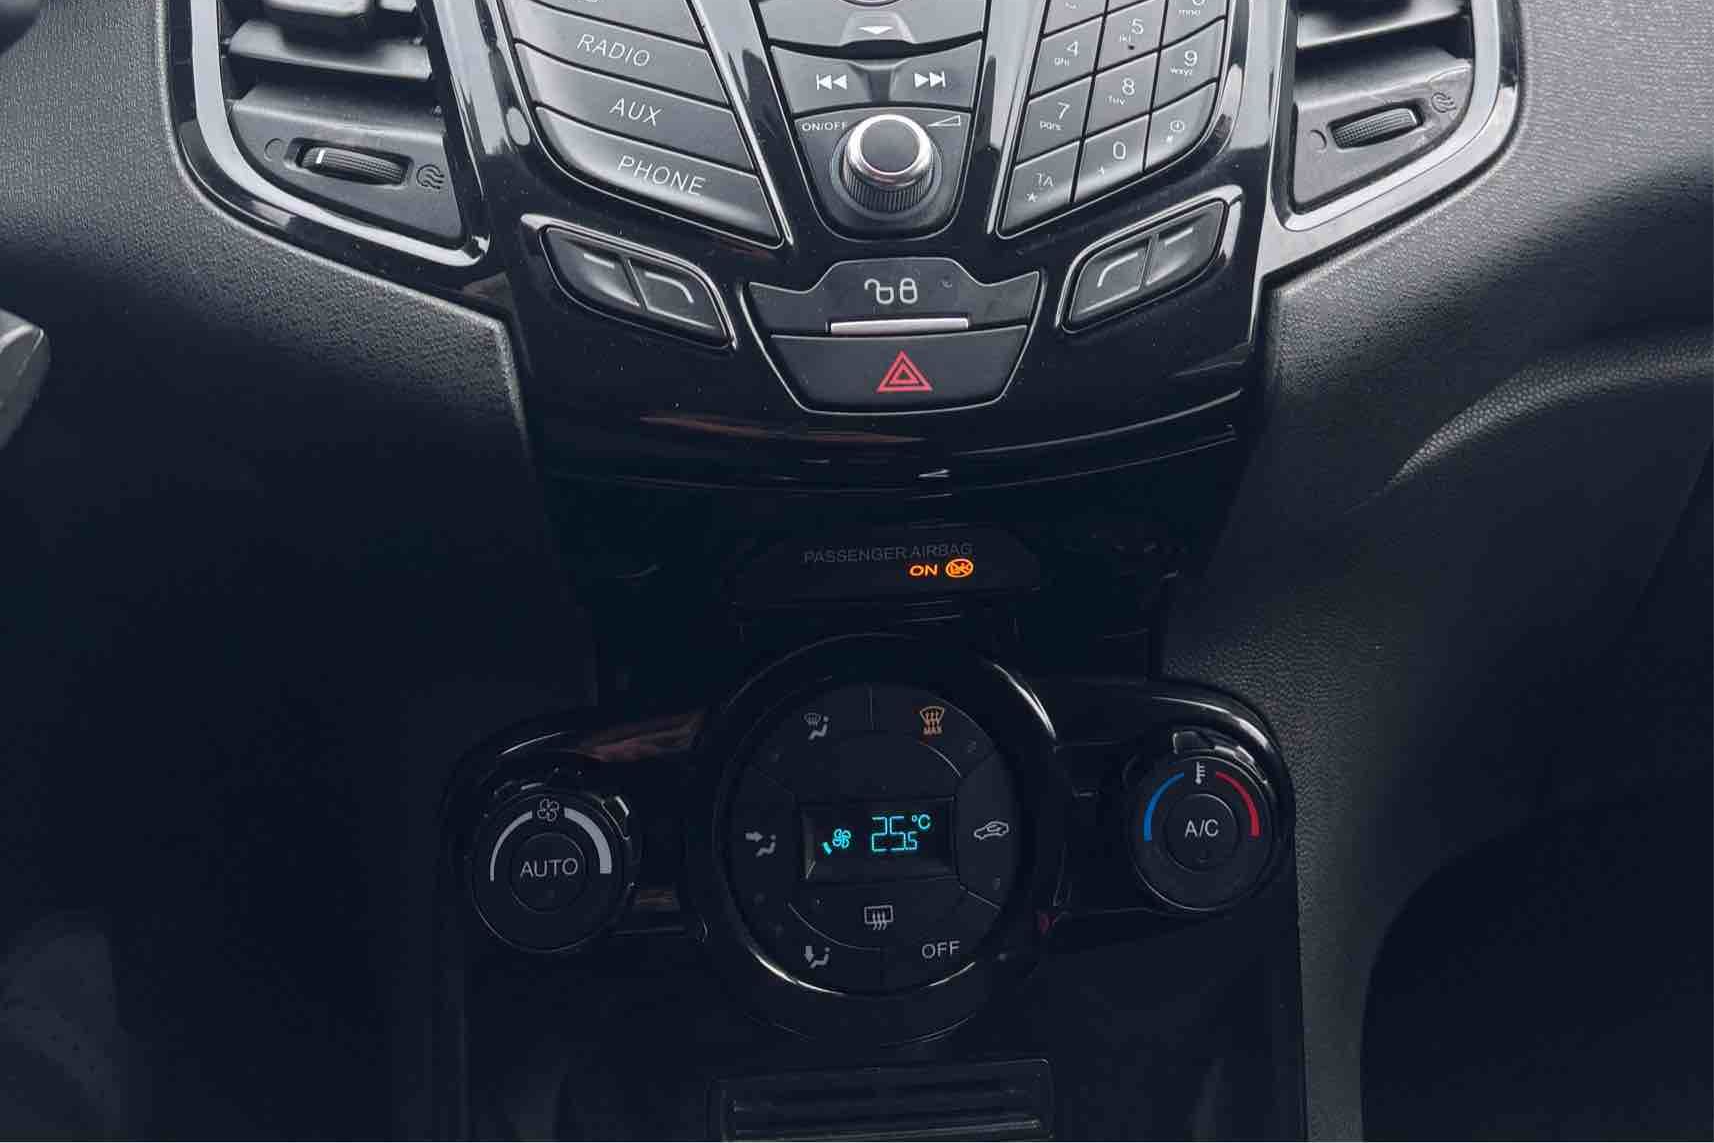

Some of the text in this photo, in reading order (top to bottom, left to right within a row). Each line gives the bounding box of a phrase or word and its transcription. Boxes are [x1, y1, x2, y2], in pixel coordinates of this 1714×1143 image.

[1131, 18, 1144, 35] 5
[576, 33, 651, 67] RADIO
[1066, 40, 1079, 56] 4
[1184, 50, 1198, 67] 9
[1122, 78, 1135, 95] 8
[609, 97, 663, 127] AUX
[1057, 101, 1070, 119] 7
[801, 121, 849, 132] ON/OFF
[1112, 141, 1126, 159] 0
[616, 154, 706, 196] PHONE
[803, 542, 974, 564] PASSENGER AIRBAG
[908, 563, 938, 577] ON
[1184, 818, 1219, 838] A/C
[519, 857, 579, 878] AUTO
[921, 940, 960, 959] OFF
